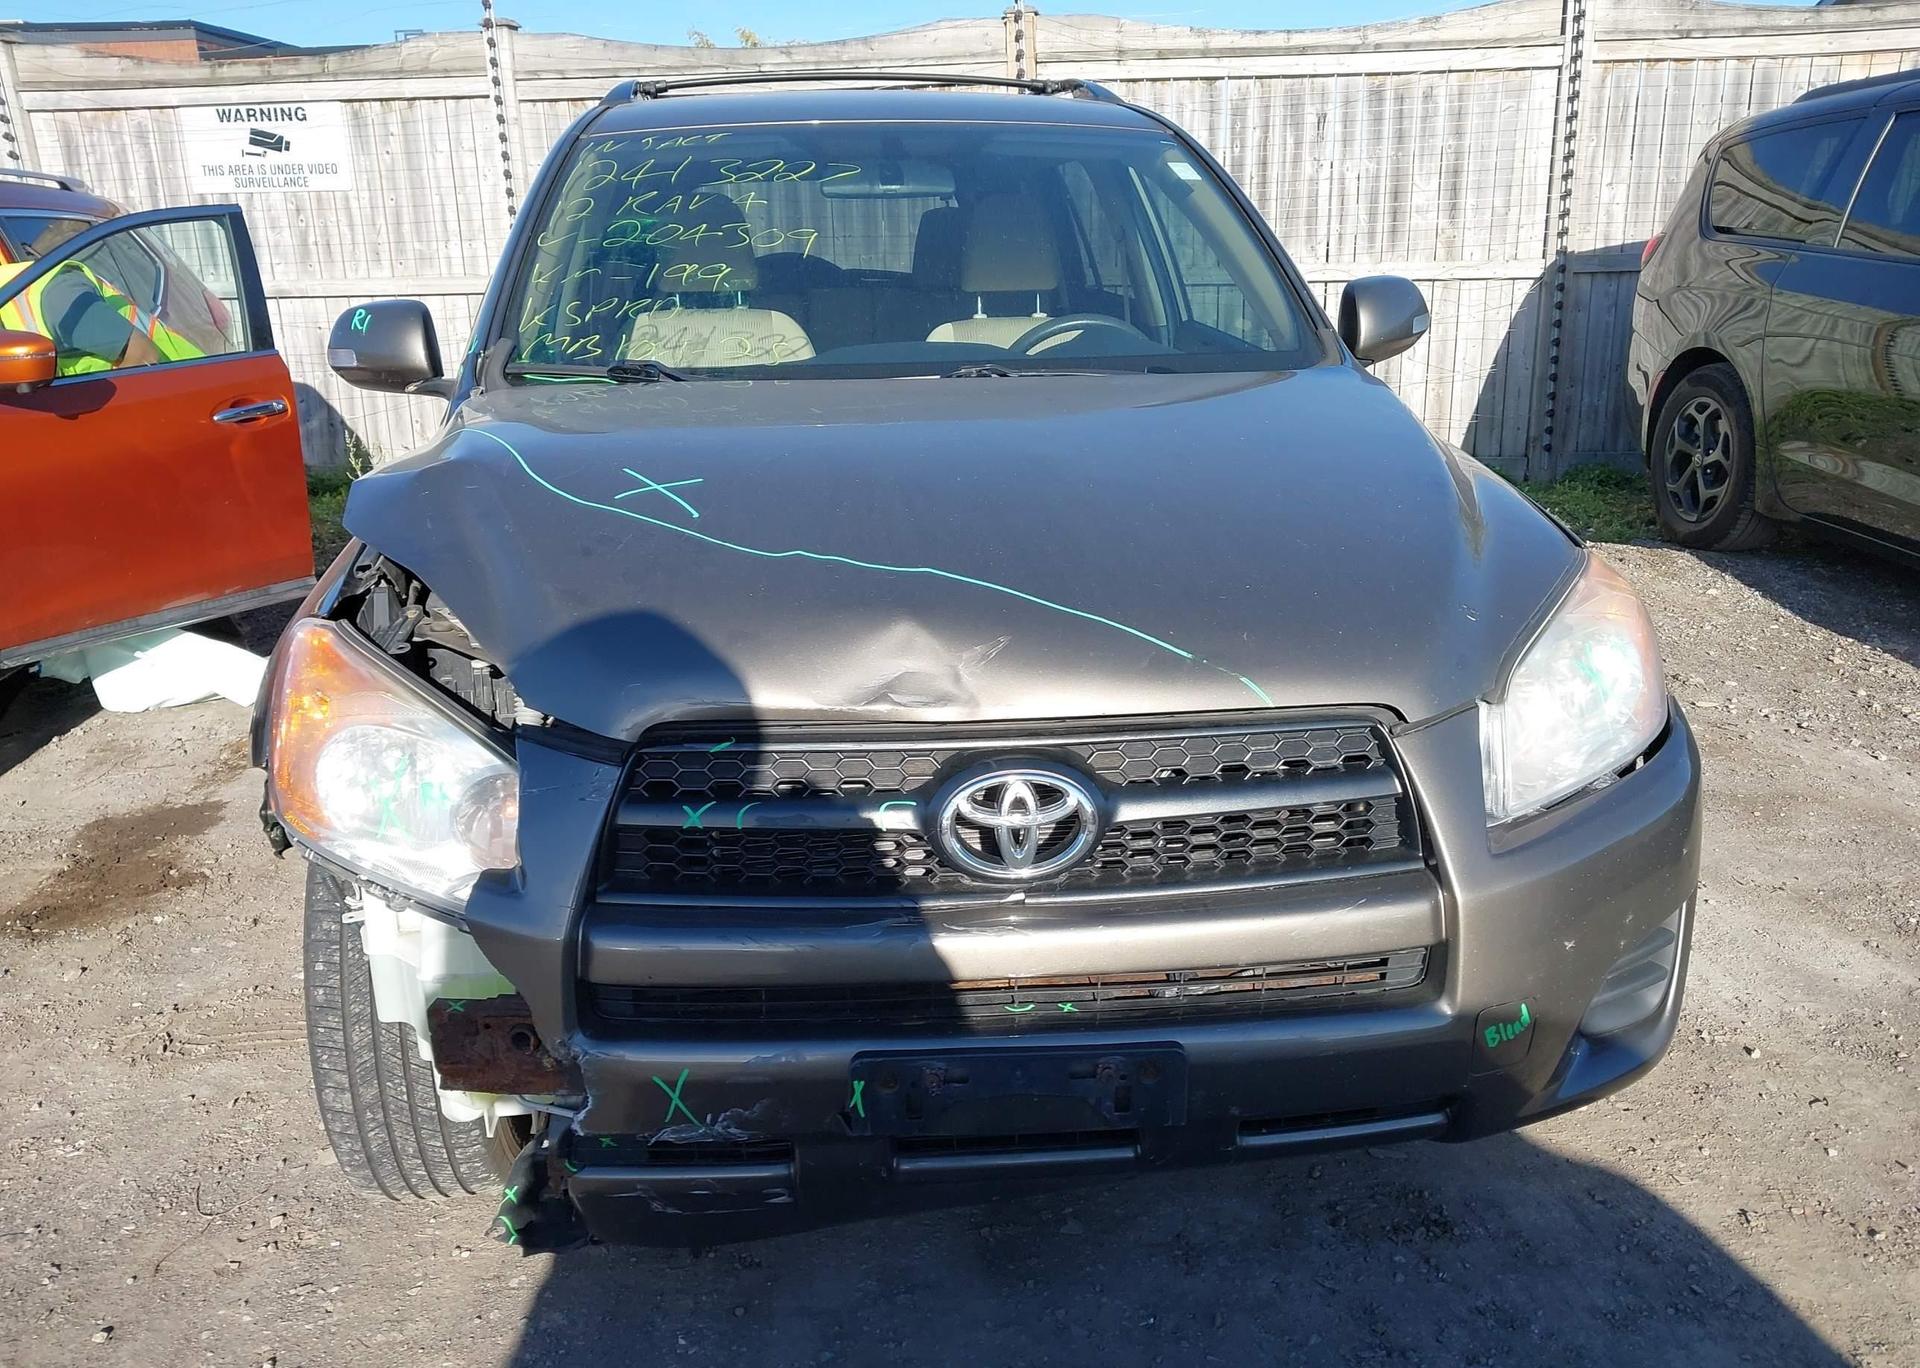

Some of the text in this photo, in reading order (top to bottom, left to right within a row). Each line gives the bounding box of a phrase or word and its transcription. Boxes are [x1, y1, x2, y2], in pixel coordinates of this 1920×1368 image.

[216, 107, 307, 122] WARNING
[202, 162, 338, 177] THIS AREA IS UNDER VIDEO
[234, 176, 310, 188] SURVEILLANCE
